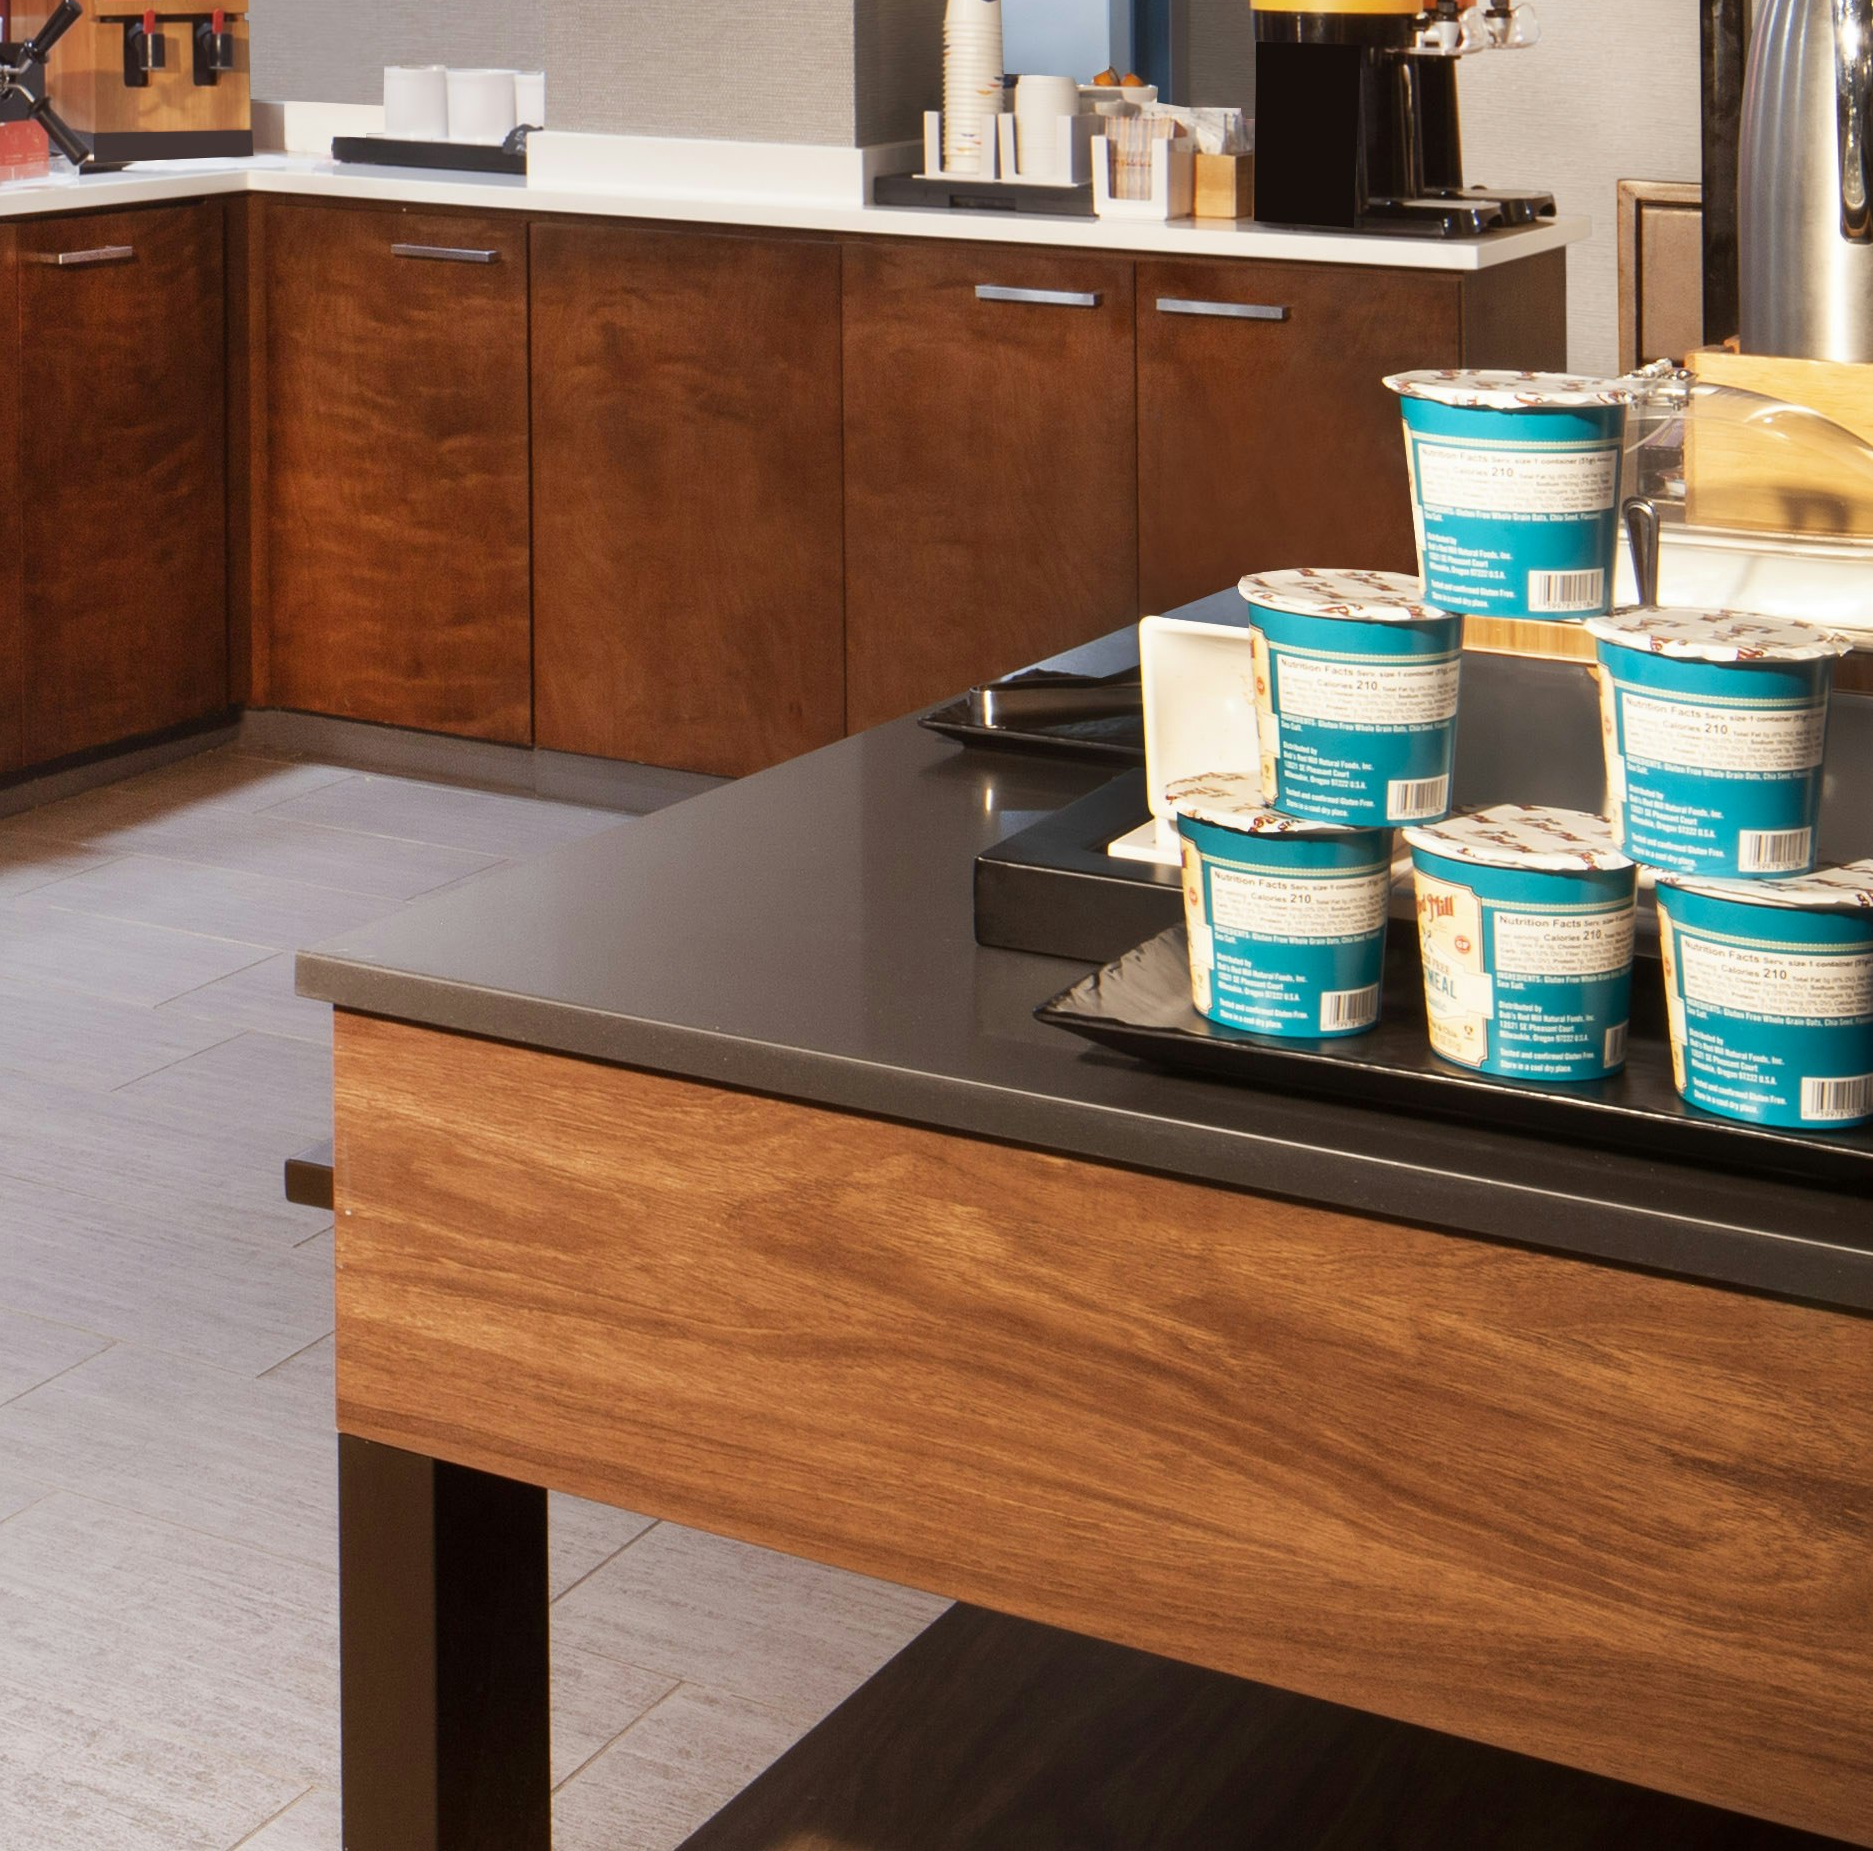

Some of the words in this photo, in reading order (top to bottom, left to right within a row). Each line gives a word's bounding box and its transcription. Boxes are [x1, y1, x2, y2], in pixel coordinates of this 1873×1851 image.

[1460, 454, 1487, 463] Facts
[1491, 467, 1514, 478] 210
[1281, 659, 1321, 672] Nutrition
[1324, 666, 1354, 676] Facts
[1317, 678, 1353, 689] Calories
[1356, 680, 1378, 691] 210
[1626, 697, 1667, 714] Nutrition
[1670, 706, 1701, 718] Facts
[1662, 720, 1700, 733] Calories
[1704, 723, 1728, 735] 210
[1214, 871, 1255, 886] Nutrition
[1258, 880, 1288, 890] Facts
[1250, 893, 1287, 904] Calories
[1290, 894, 1312, 905] 210
[1427, 895, 1455, 922] Mill
[1500, 915, 1549, 927] Nutrition
[1553, 918, 1581, 928] Facts
[1544, 933, 1580, 942] Calories
[1583, 929, 1601, 941] 210
[1684, 940, 1725, 957] Nutrition
[1728, 951, 1759, 963] Facts
[1721, 964, 1759, 977] Calories
[1763, 968, 1787, 980] 210
[1745, 1010, 1762, 1022] Free
[1763, 1013, 1784, 1025] Whole
